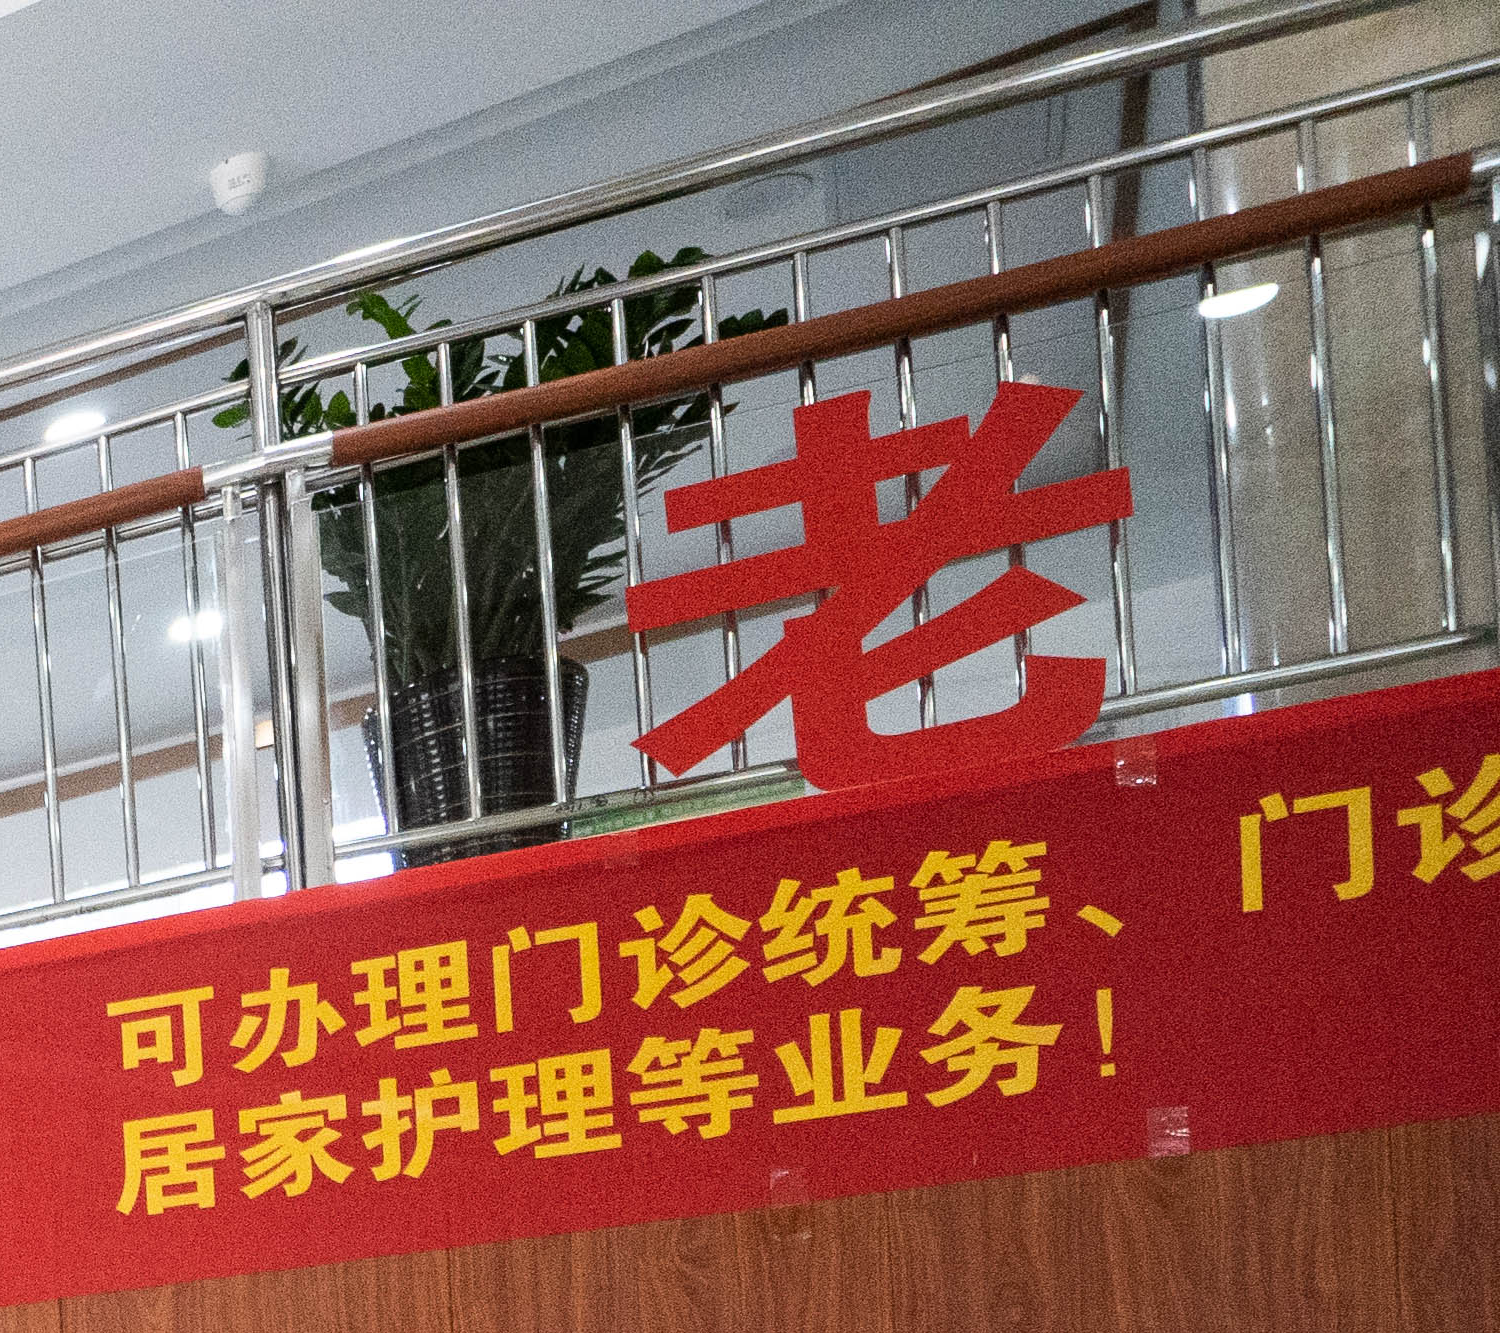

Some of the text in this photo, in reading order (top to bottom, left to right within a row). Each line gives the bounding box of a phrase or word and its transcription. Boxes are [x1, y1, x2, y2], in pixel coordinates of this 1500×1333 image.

[116, 986, 1120, 1216] 居家护理等业务！
